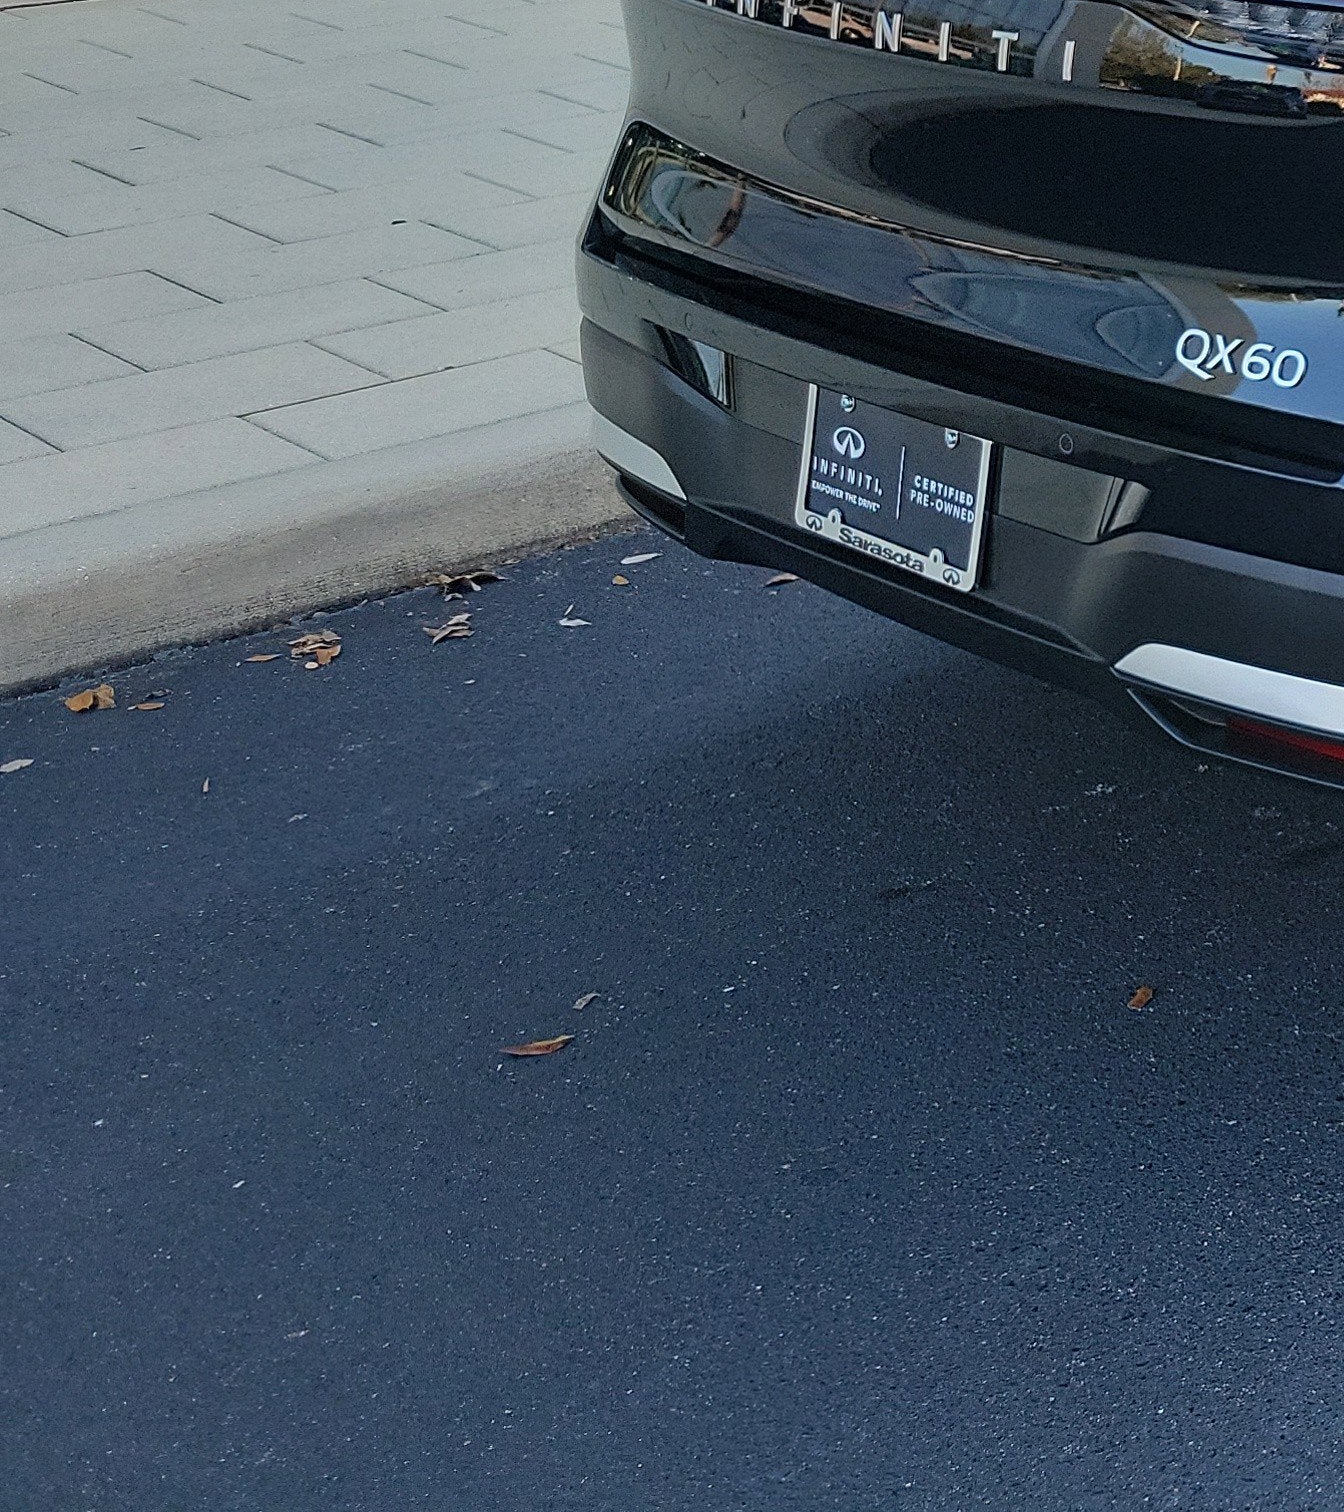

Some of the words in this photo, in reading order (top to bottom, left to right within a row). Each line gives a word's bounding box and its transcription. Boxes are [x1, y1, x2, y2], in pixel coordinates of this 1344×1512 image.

[1175, 328, 1308, 388] QX60
[811, 479, 844, 500] EMPOWER
[845, 491, 858, 505] THE
[812, 455, 880, 494] INFINITI
[914, 474, 974, 507] CERTIFIED
[910, 489, 975, 524] PRE-OWNED
[838, 527, 926, 574] Sarasota
